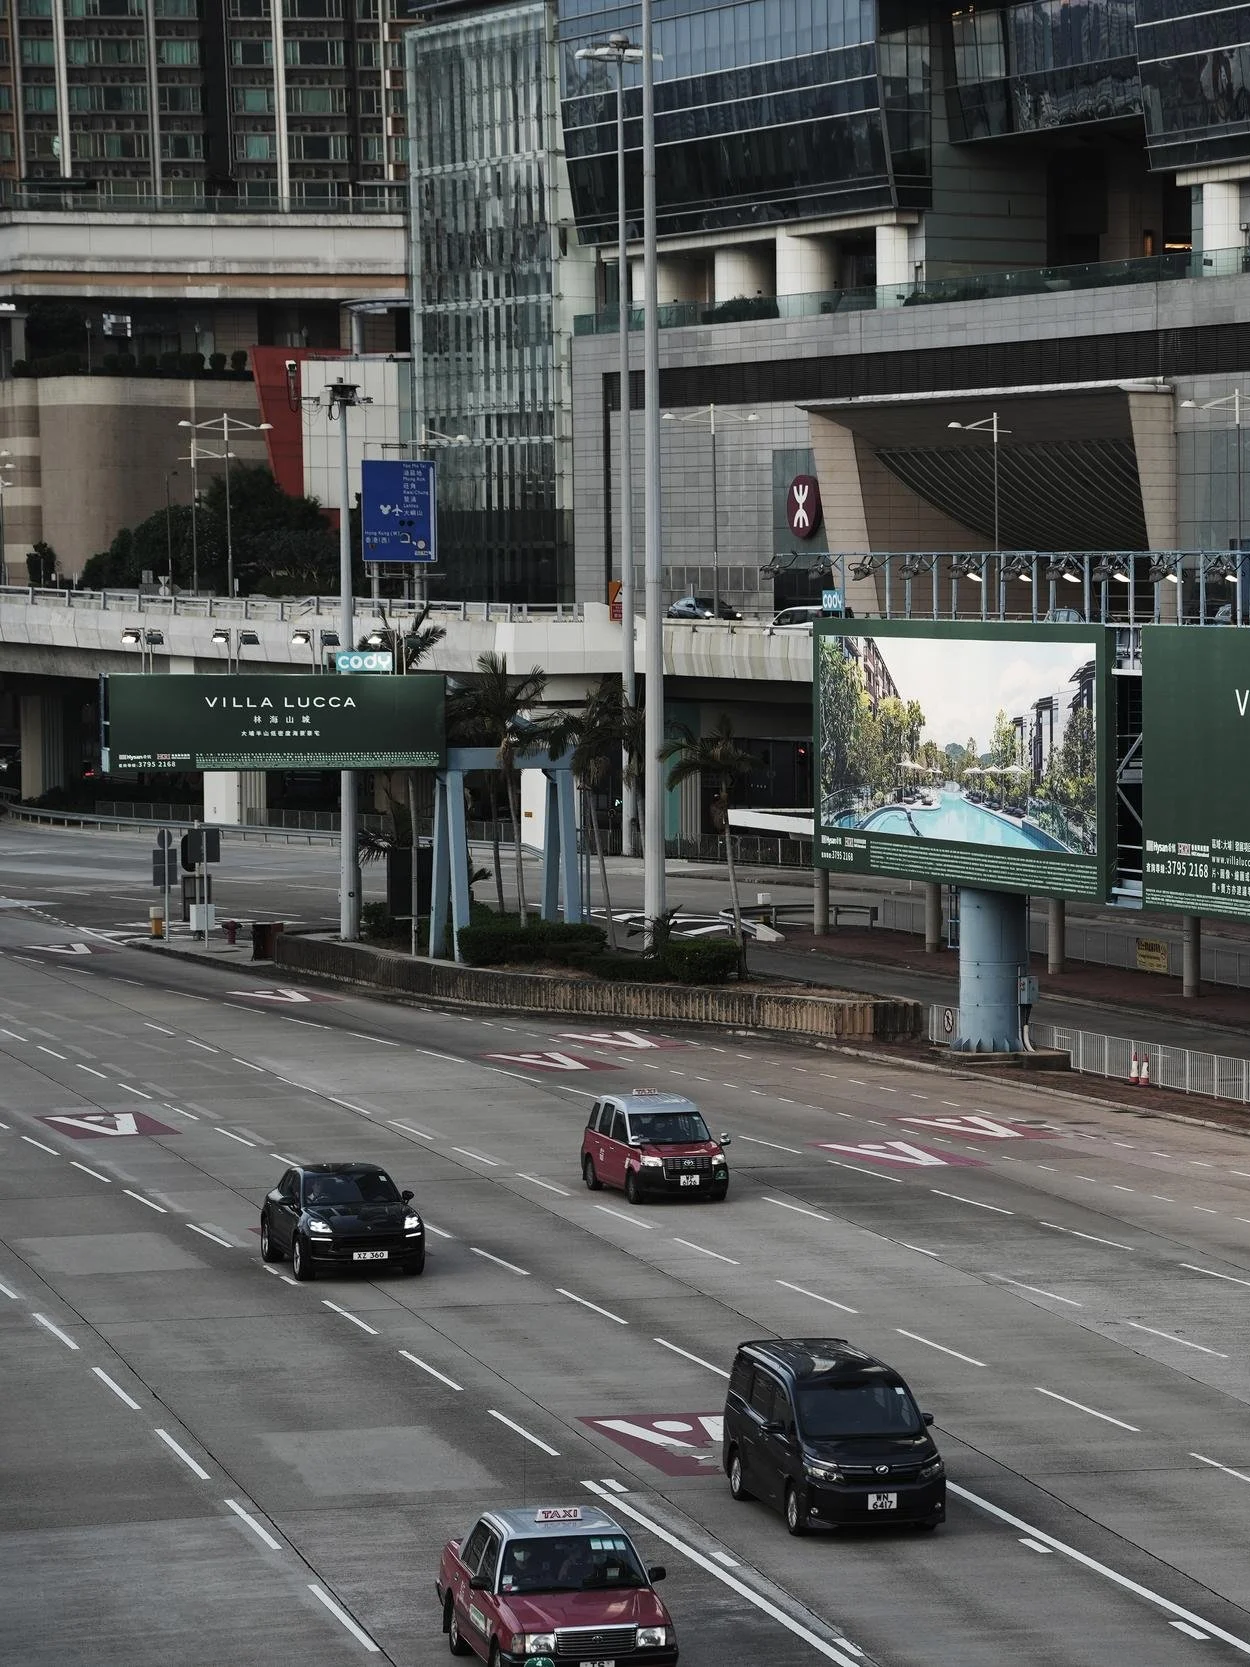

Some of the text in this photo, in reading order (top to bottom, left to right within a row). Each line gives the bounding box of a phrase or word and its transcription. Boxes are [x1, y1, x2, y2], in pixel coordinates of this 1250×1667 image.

[205, 696, 357, 708] VILLA LUCCA
[253, 715, 311, 724] 林海山城
[843, 852, 854, 861] 2168
[1168, 860, 1186, 876] 3795
[1189, 863, 1209, 878] 2168
[872, 1500, 893, 1509] 6417
[541, 1508, 578, 1518] TAXI
